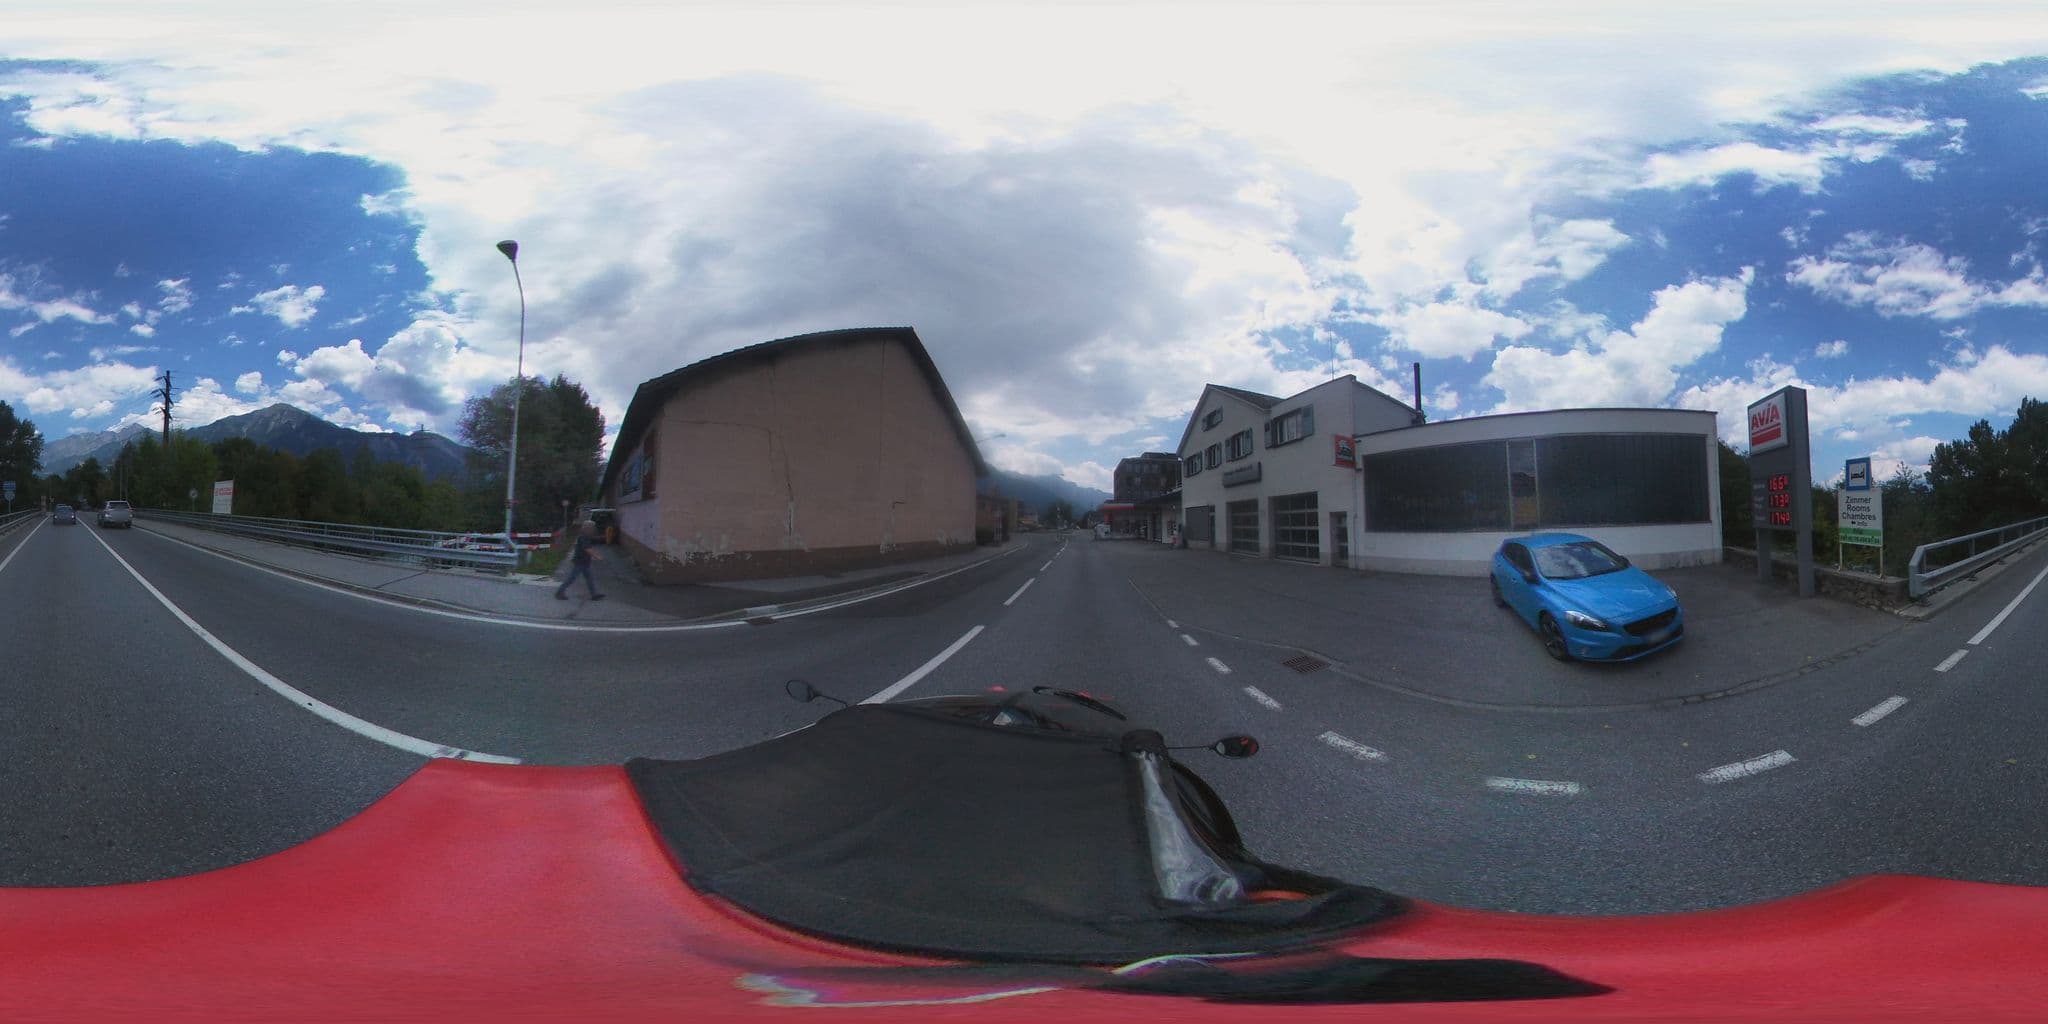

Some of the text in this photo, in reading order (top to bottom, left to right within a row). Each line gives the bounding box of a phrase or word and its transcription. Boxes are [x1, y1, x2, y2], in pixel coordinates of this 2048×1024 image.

[1845, 496, 1872, 504] Zimmer
[1846, 504, 1871, 512] Rooms
[1842, 512, 1876, 521] Chambres
